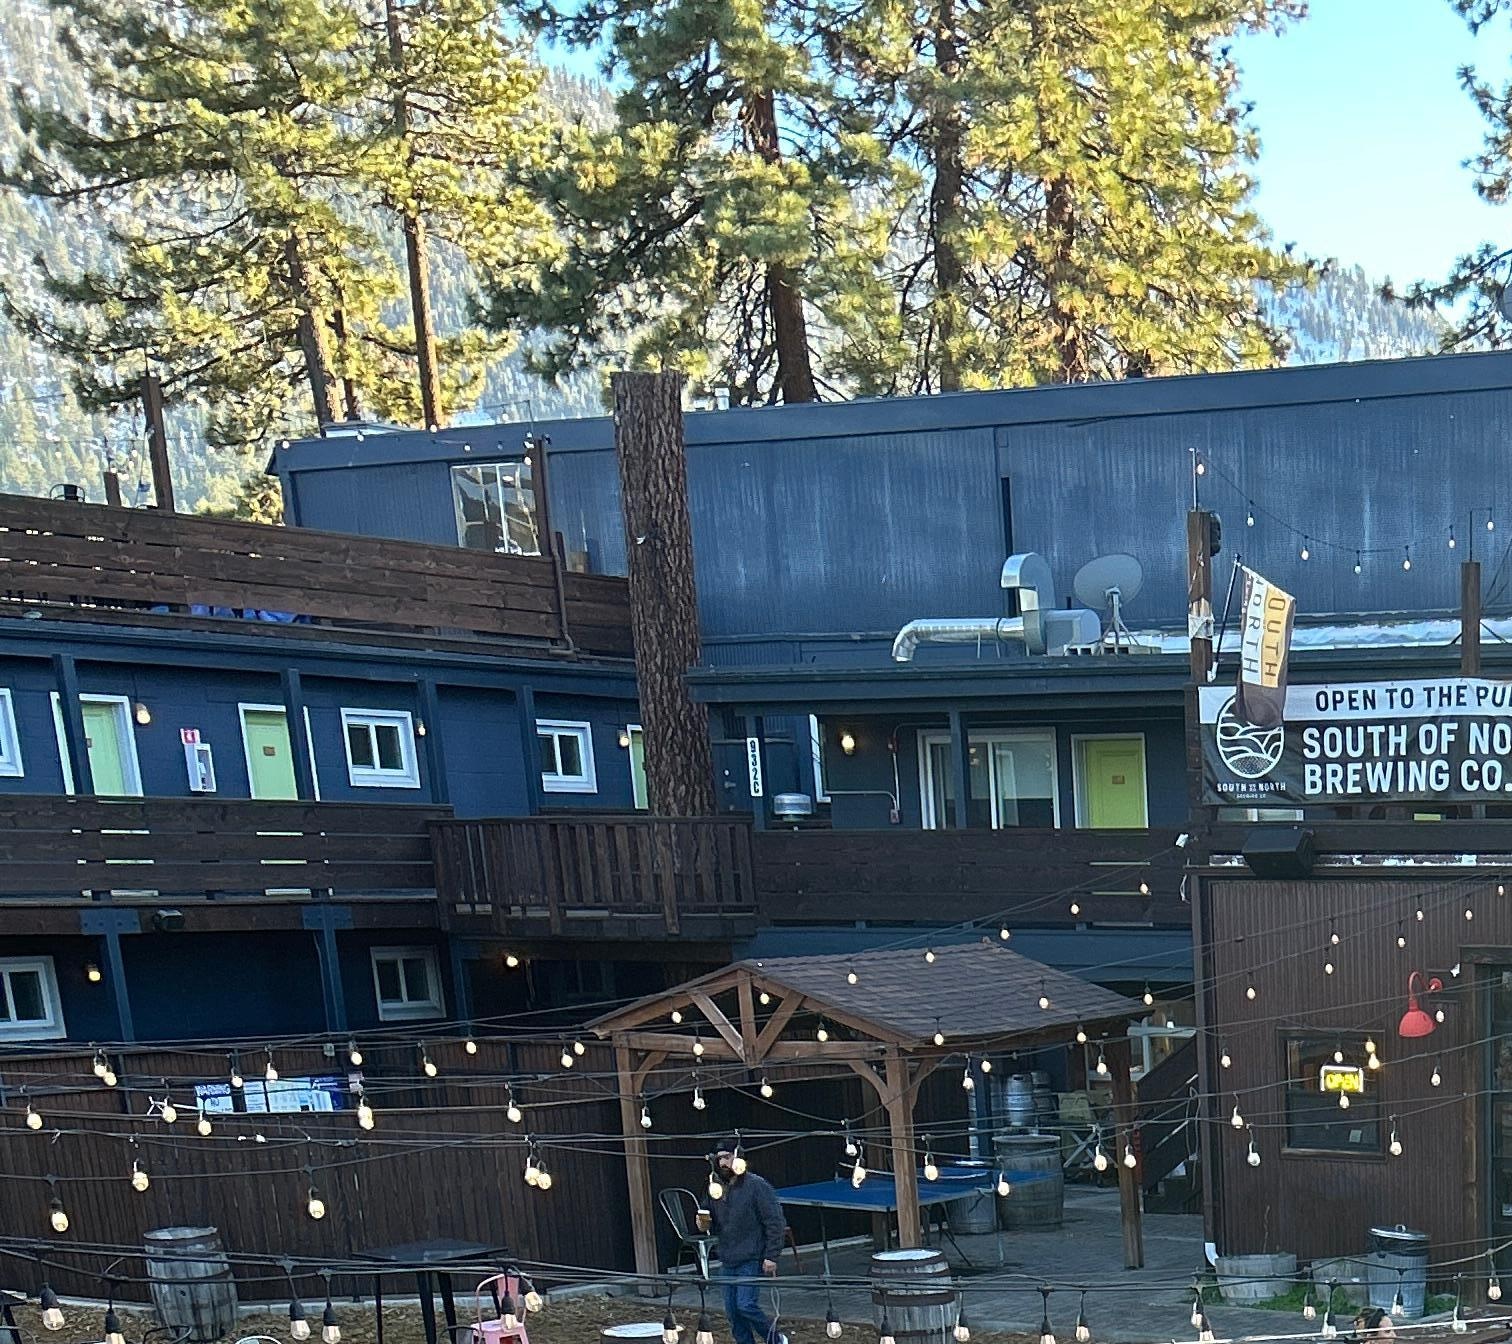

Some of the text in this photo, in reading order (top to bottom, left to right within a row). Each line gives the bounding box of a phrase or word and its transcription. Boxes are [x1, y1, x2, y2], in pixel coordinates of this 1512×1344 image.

[1265, 588, 1286, 677] OUTH
[1315, 689, 1376, 712] OPEN
[1385, 687, 1414, 709] TO
[1423, 685, 1468, 708] THE
[1302, 724, 1407, 759] SOUTH
[1418, 722, 1459, 756] OF
[1216, 782, 1247, 792] SOUTH
[1258, 781, 1286, 792] NORTH
[1304, 759, 1450, 795] BREWING
[1325, 1072, 1359, 1090] OPEN
